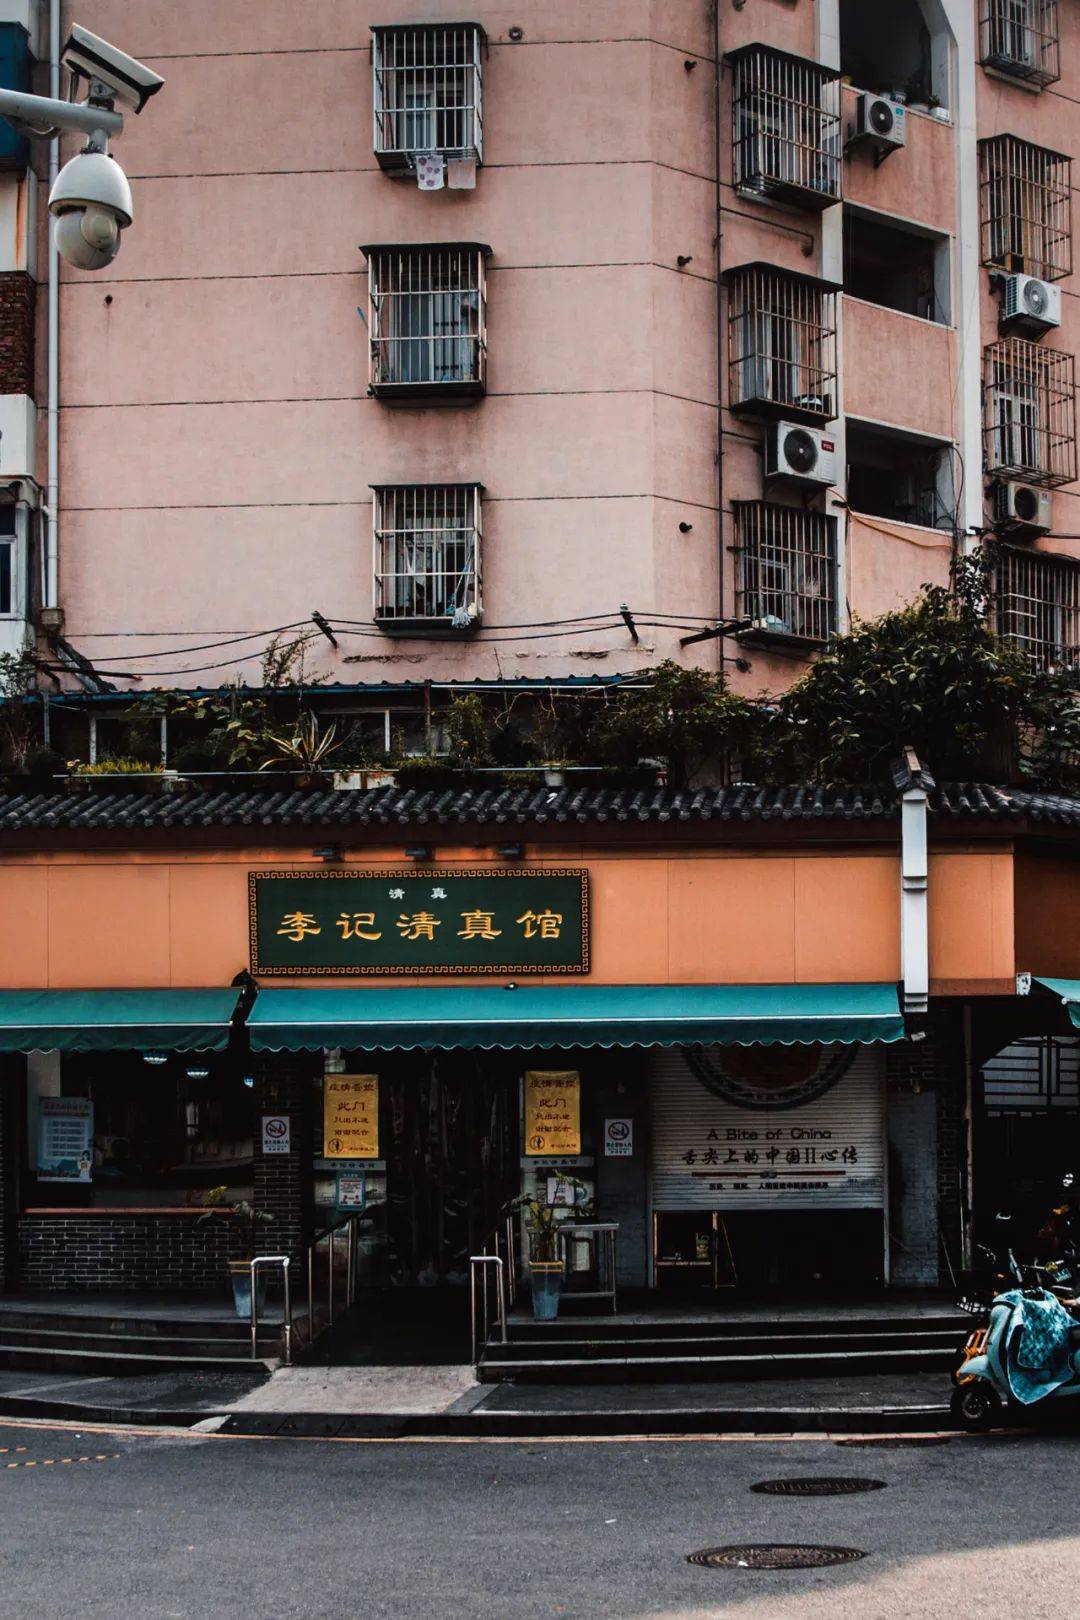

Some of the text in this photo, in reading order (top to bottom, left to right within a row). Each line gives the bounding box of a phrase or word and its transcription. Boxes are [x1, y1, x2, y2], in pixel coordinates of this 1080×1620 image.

[389, 887, 447, 899] 清真
[277, 909, 563, 942] 李记清真馆
[706, 1127, 832, 1140] A Bite of China
